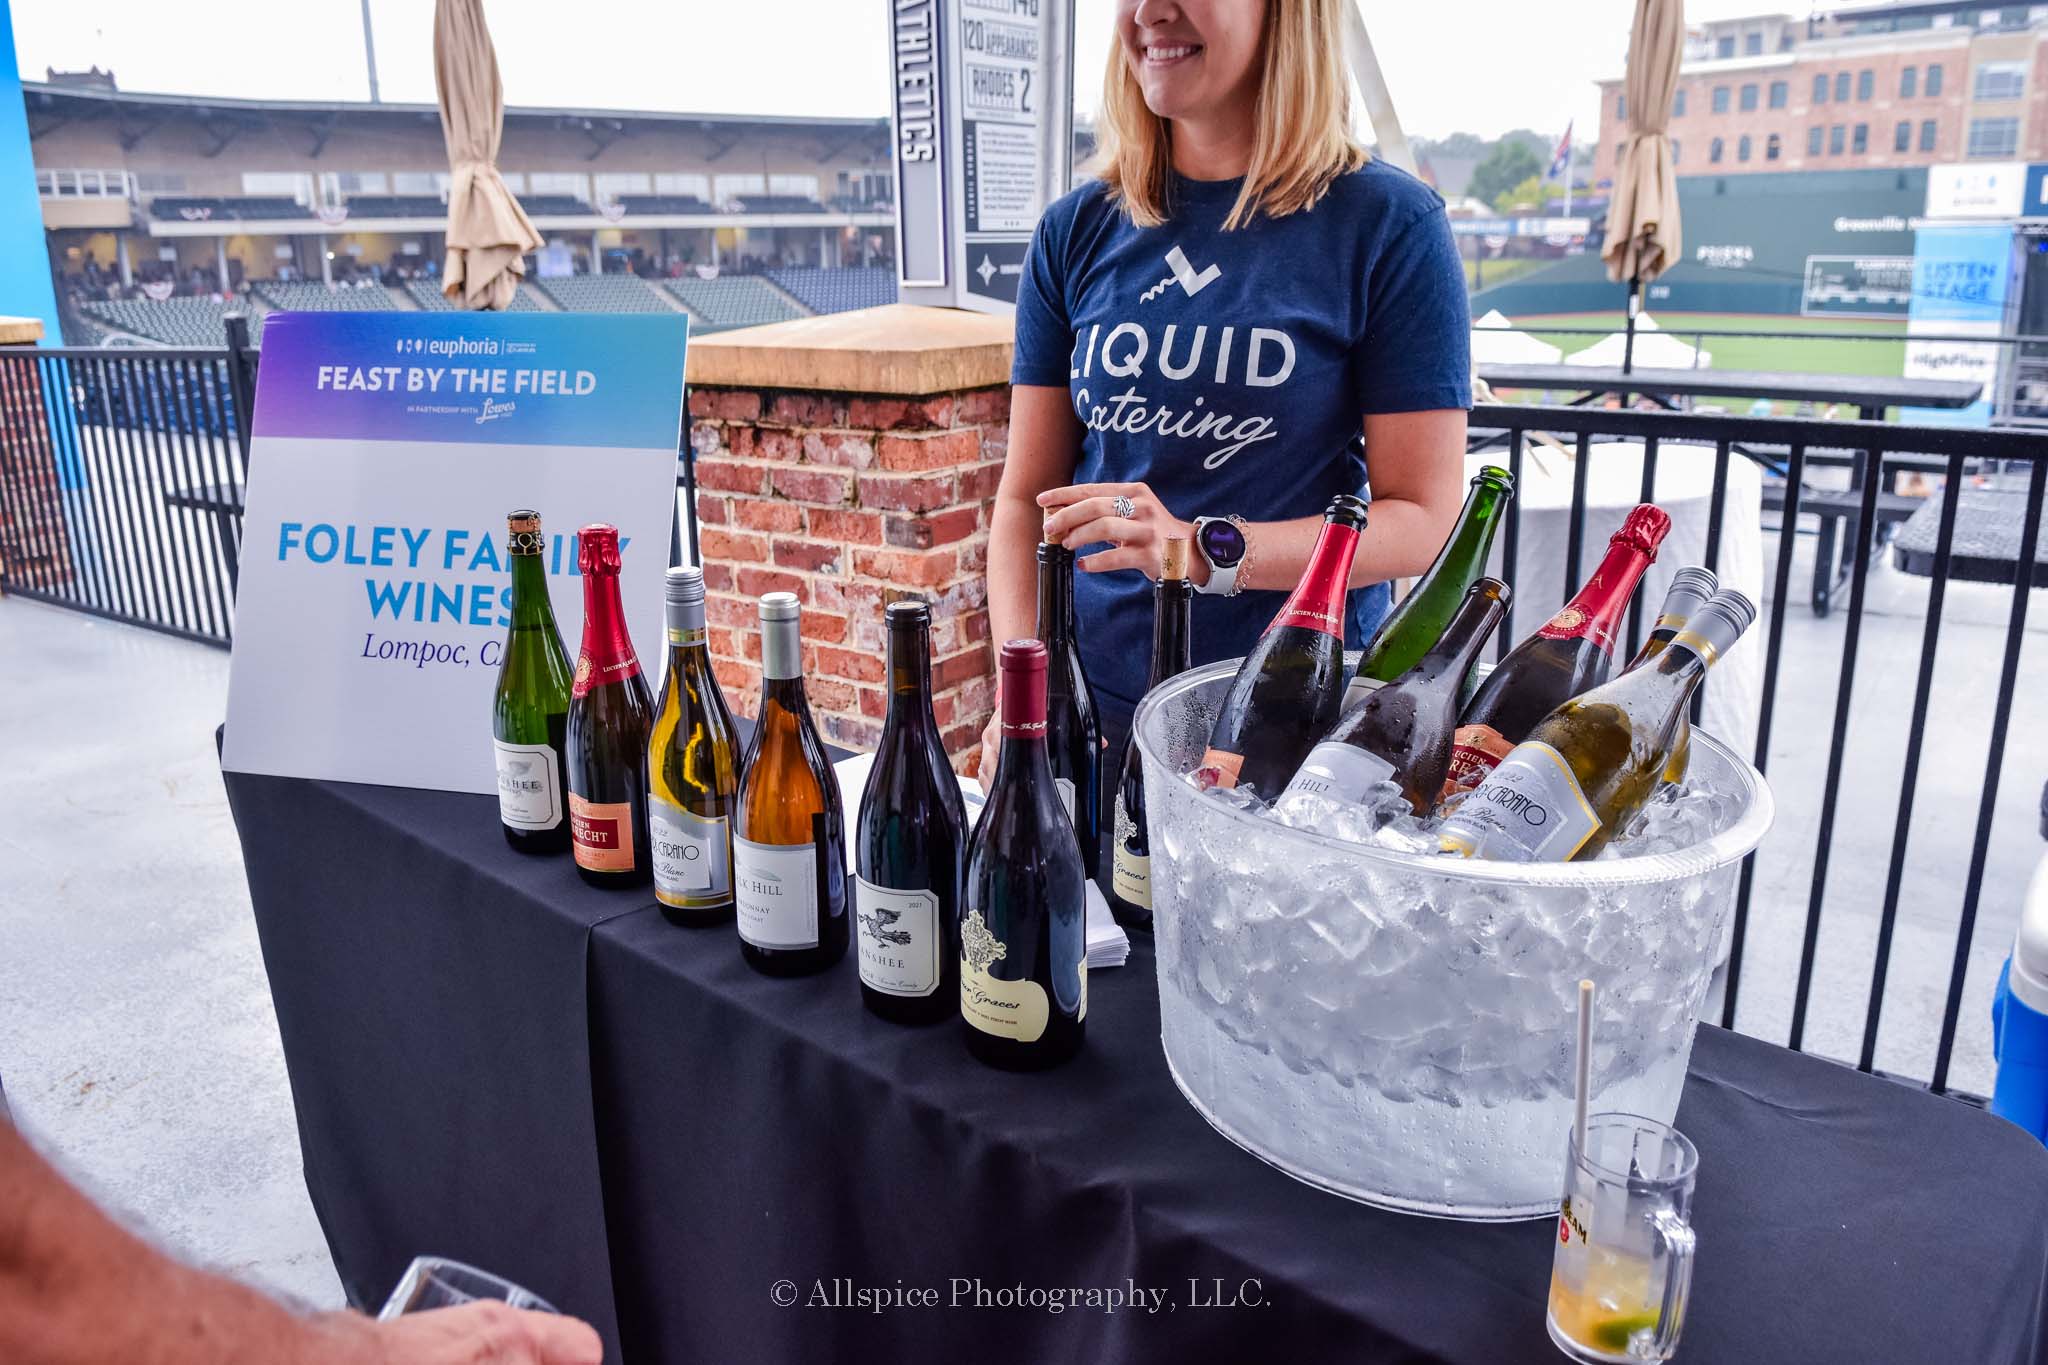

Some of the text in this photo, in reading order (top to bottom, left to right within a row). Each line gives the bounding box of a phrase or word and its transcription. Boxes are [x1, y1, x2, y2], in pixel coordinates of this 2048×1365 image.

[963, 18, 984, 51] 120
[973, 68, 1031, 113] RHODES 2
[1923, 262, 1997, 281] LISTEN
[429, 336, 499, 359] euphoria
[1070, 322, 1297, 387] LIQUID
[317, 366, 598, 396] FEAST BY THE FIELD
[1076, 385, 1279, 470] Catering
[278, 522, 633, 577] FOLEY FAIL
[361, 632, 471, 670] Lompoc,
[752, 880, 784, 897] HILL
[972, 987, 1021, 1009] Graces
